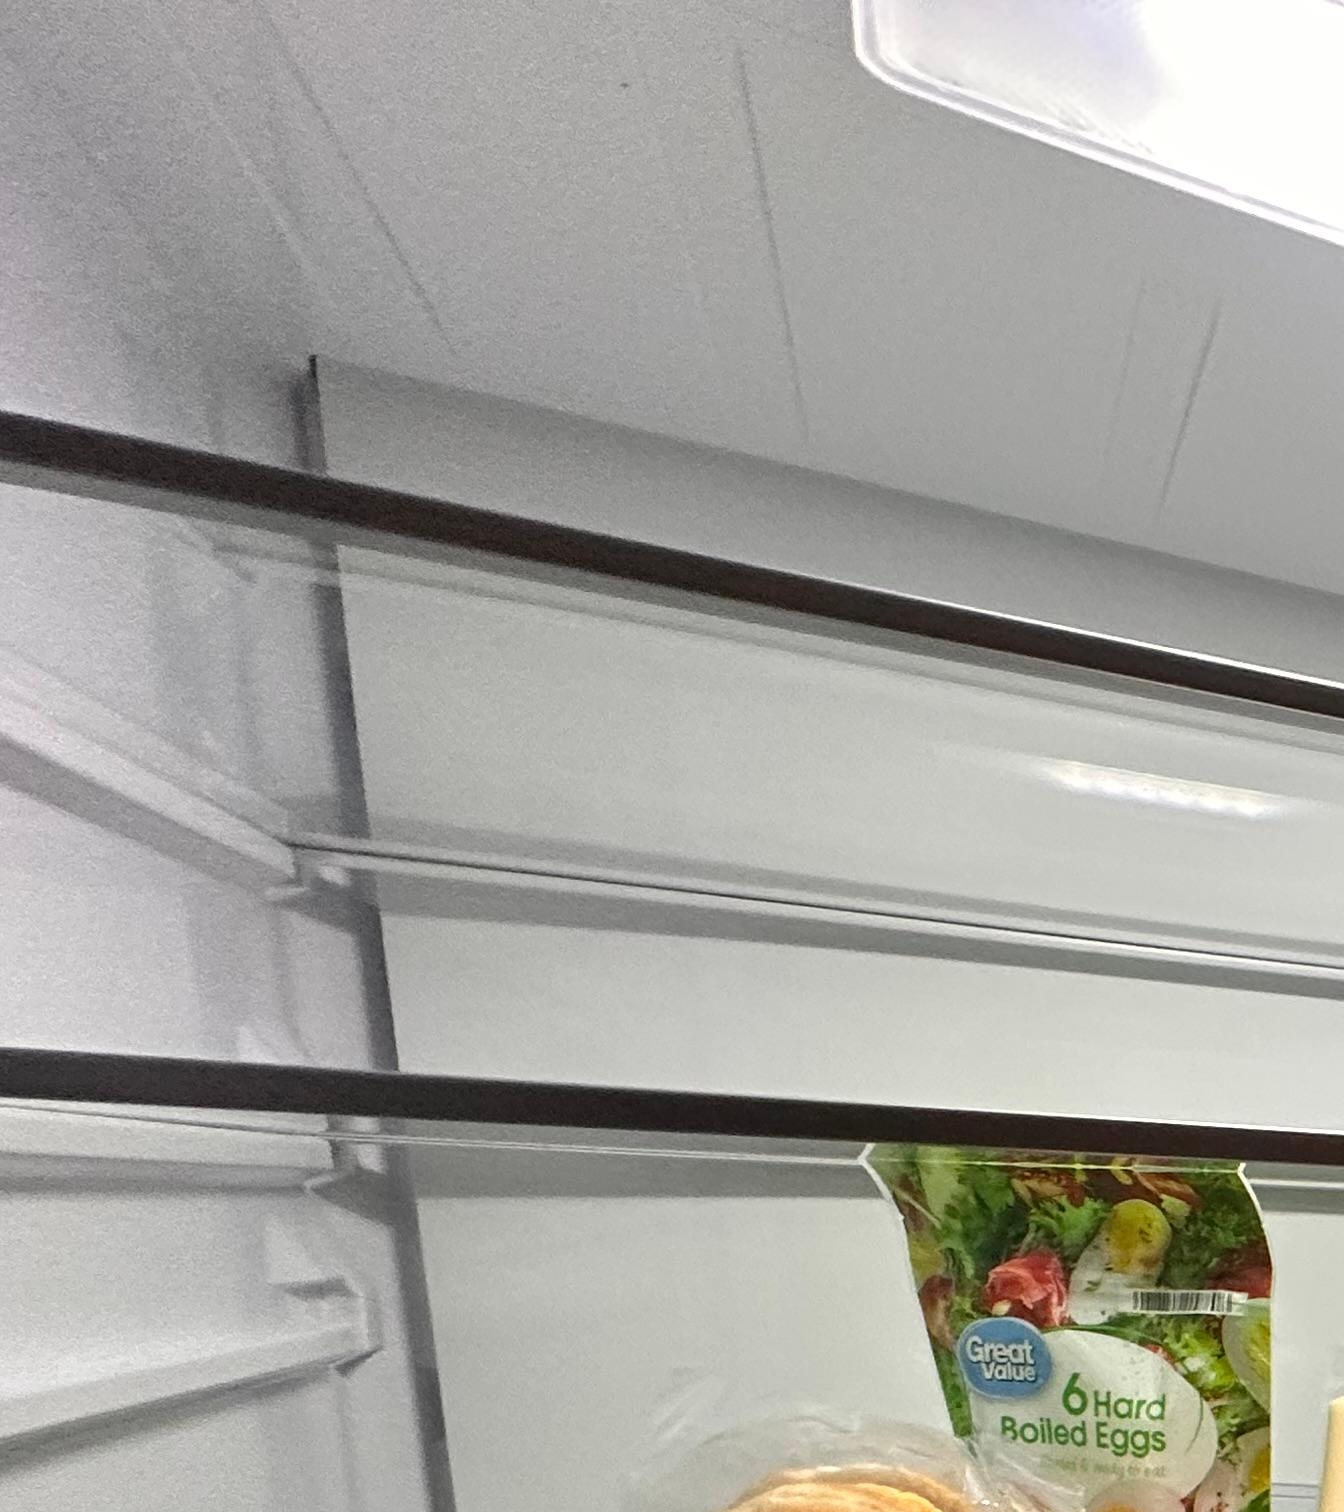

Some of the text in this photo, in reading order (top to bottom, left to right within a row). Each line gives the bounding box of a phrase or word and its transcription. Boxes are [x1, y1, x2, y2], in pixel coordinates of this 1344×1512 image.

[966, 1336, 1037, 1365] Great
[982, 1363, 1037, 1382] Value
[1061, 1372, 1167, 1421] 6 Hard
[1000, 1414, 1167, 1459] Boiled Eggs
